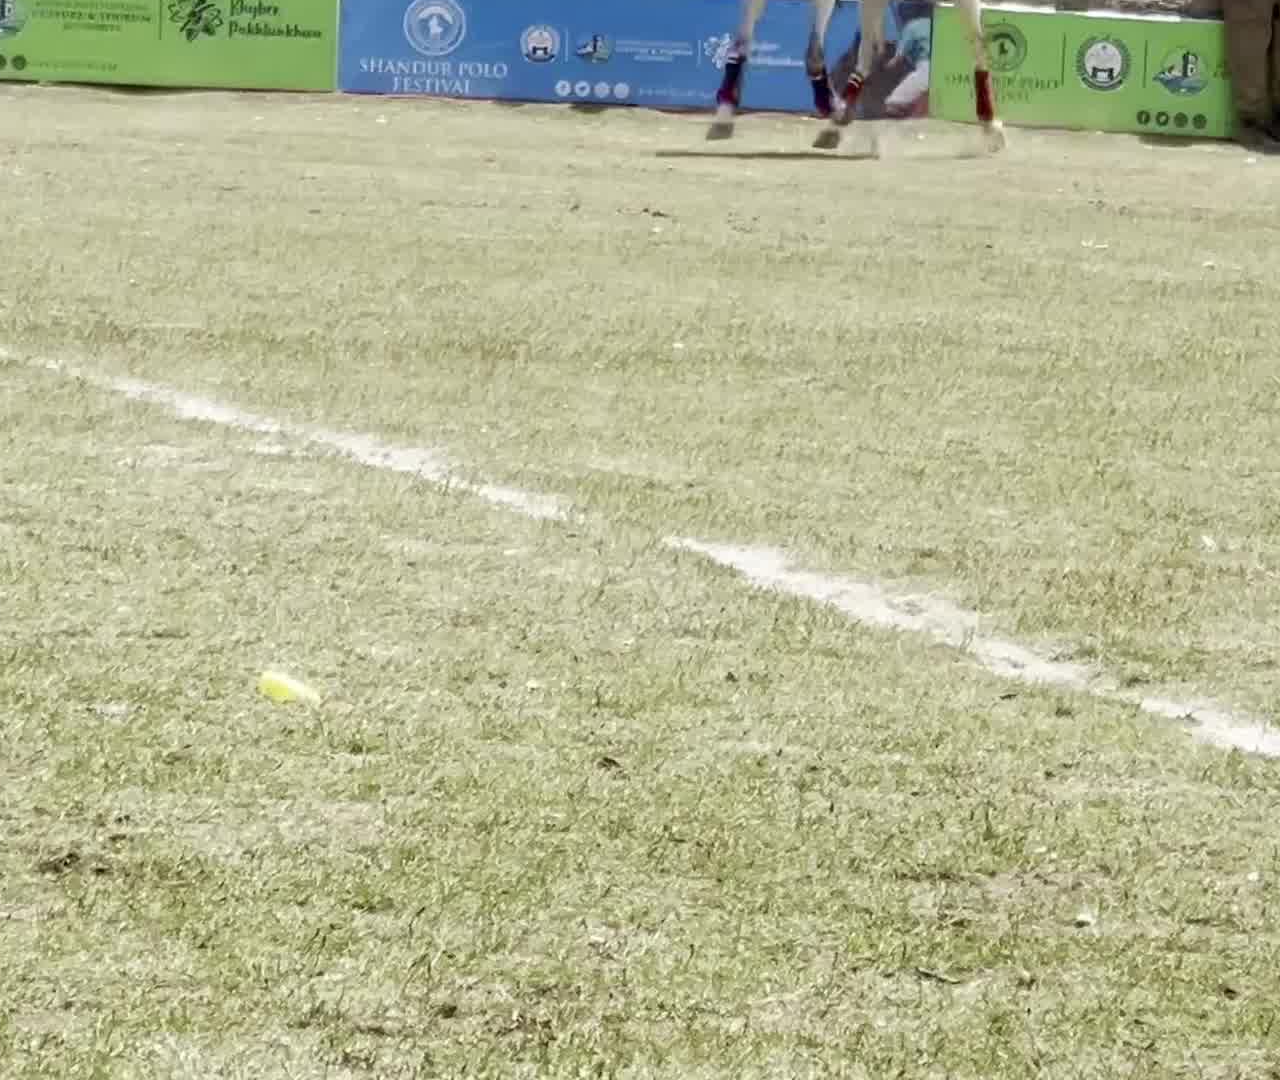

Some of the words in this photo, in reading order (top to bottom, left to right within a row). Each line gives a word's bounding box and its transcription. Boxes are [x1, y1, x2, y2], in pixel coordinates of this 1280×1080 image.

[360, 57, 451, 76] SHANDUR
[459, 62, 508, 79] POLO
[392, 75, 470, 95] FESTIVAL
